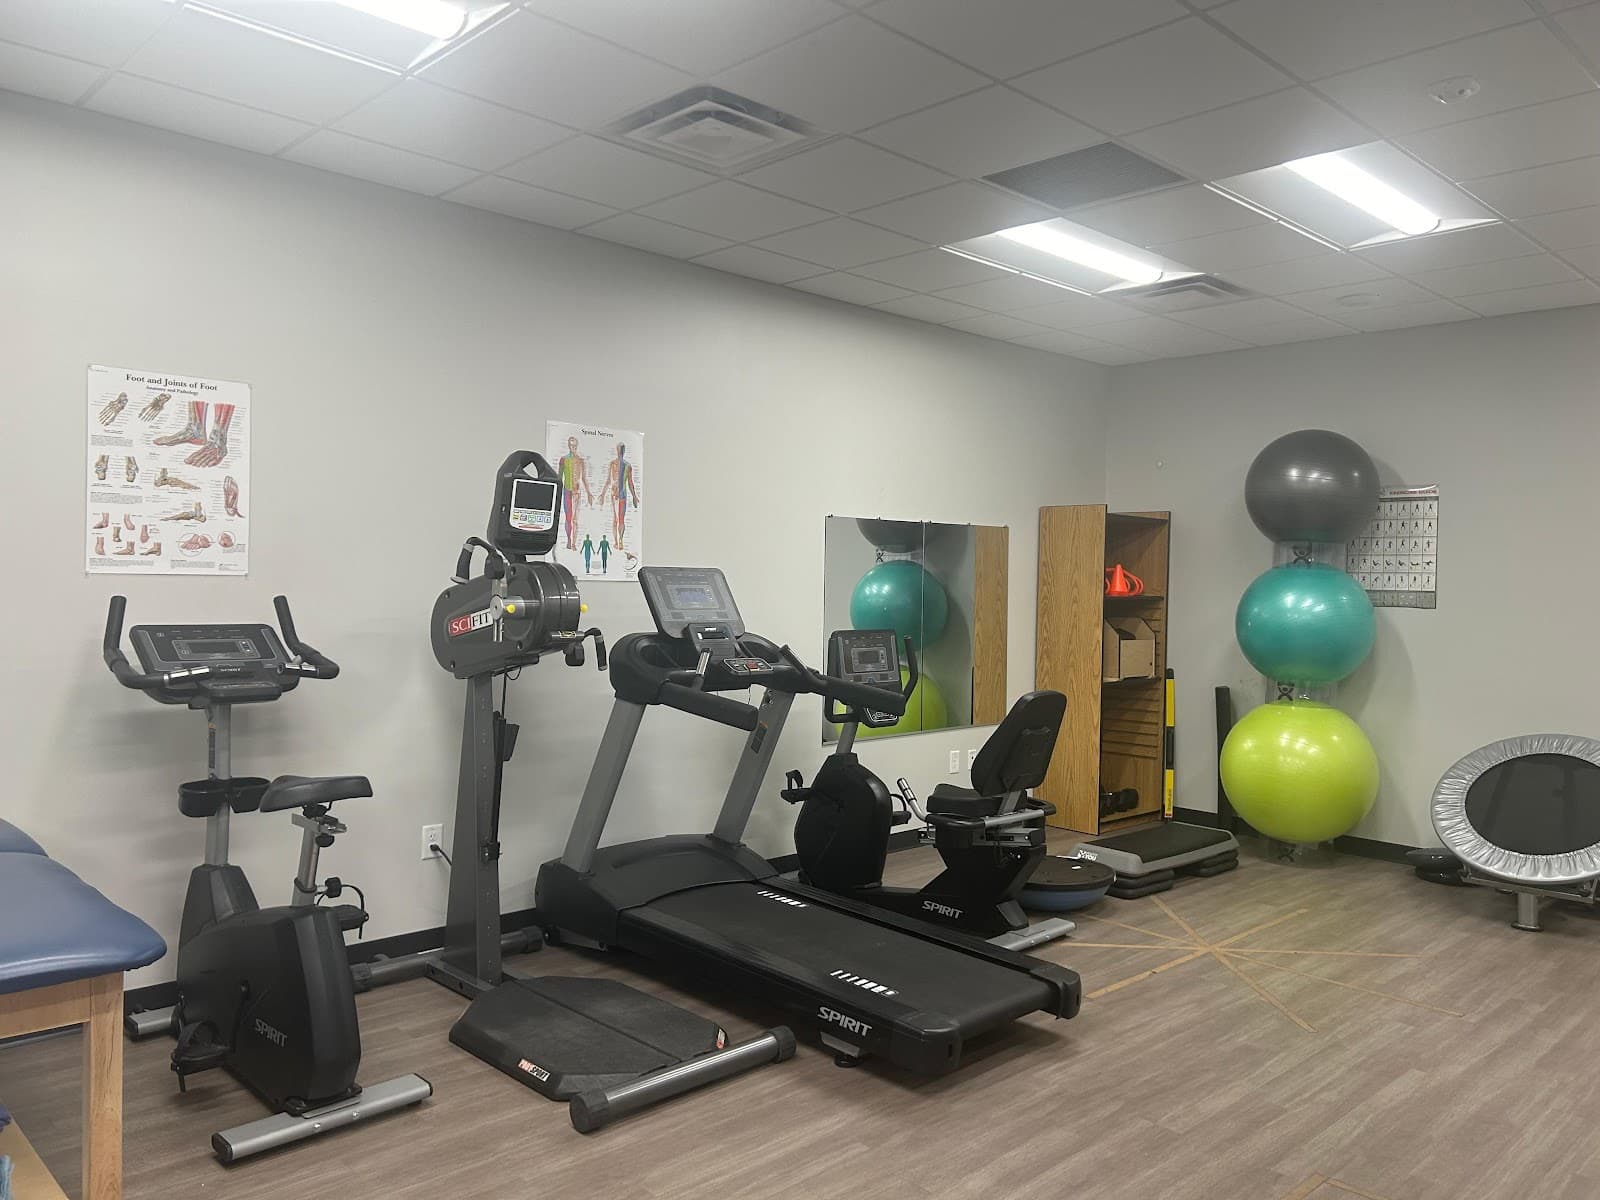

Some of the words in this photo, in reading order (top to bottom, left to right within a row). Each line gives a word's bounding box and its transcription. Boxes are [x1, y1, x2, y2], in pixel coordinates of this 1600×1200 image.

[126, 374, 145, 383] Foot
[147, 377, 162, 385] and
[163, 378, 187, 388] Joints
[200, 382, 218, 391] Foot
[451, 611, 491, 633] SCIFIT
[921, 900, 963, 919] SPIRIT
[255, 1018, 288, 1047] SPIRIT
[817, 1006, 872, 1037] SPIRIT
